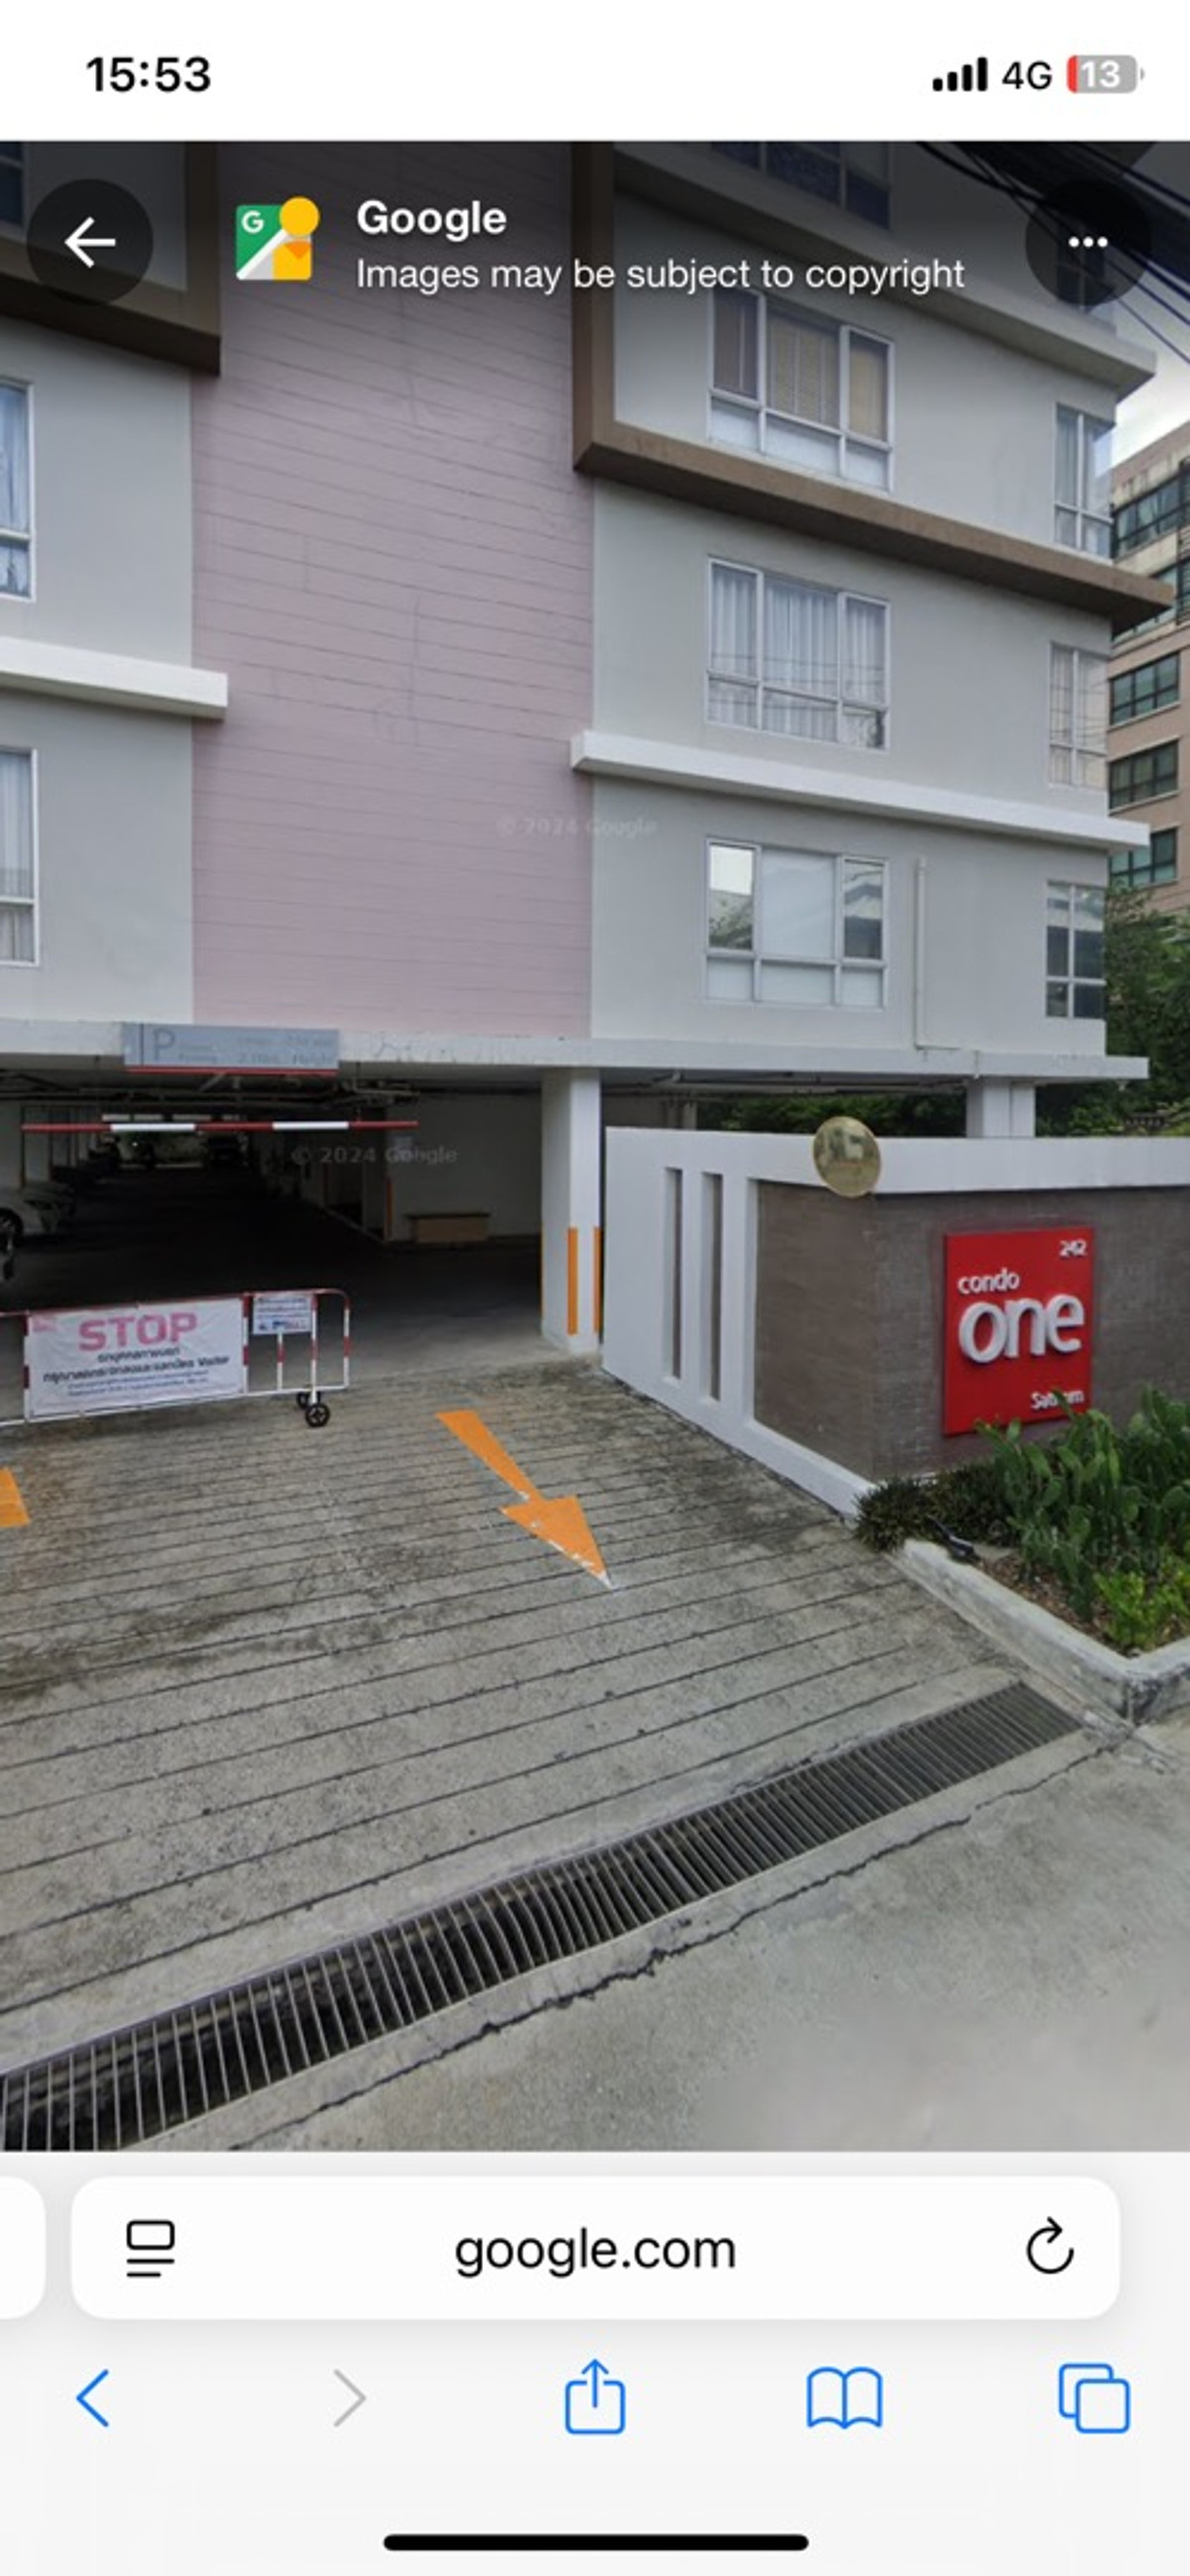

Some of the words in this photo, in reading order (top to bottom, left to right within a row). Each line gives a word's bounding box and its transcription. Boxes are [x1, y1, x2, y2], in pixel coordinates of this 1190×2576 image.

[86, 57, 211, 92] 15:53
[1002, 61, 1052, 90] 4G
[1081, 61, 1120, 88] 13
[152, 1028, 177, 1061] P
[1058, 1239, 1088, 1257] 242
[957, 1268, 1020, 1294] condo
[78, 1311, 198, 1352] STOP
[958, 1293, 1085, 1364] one
[455, 2227, 736, 2278] google.com
